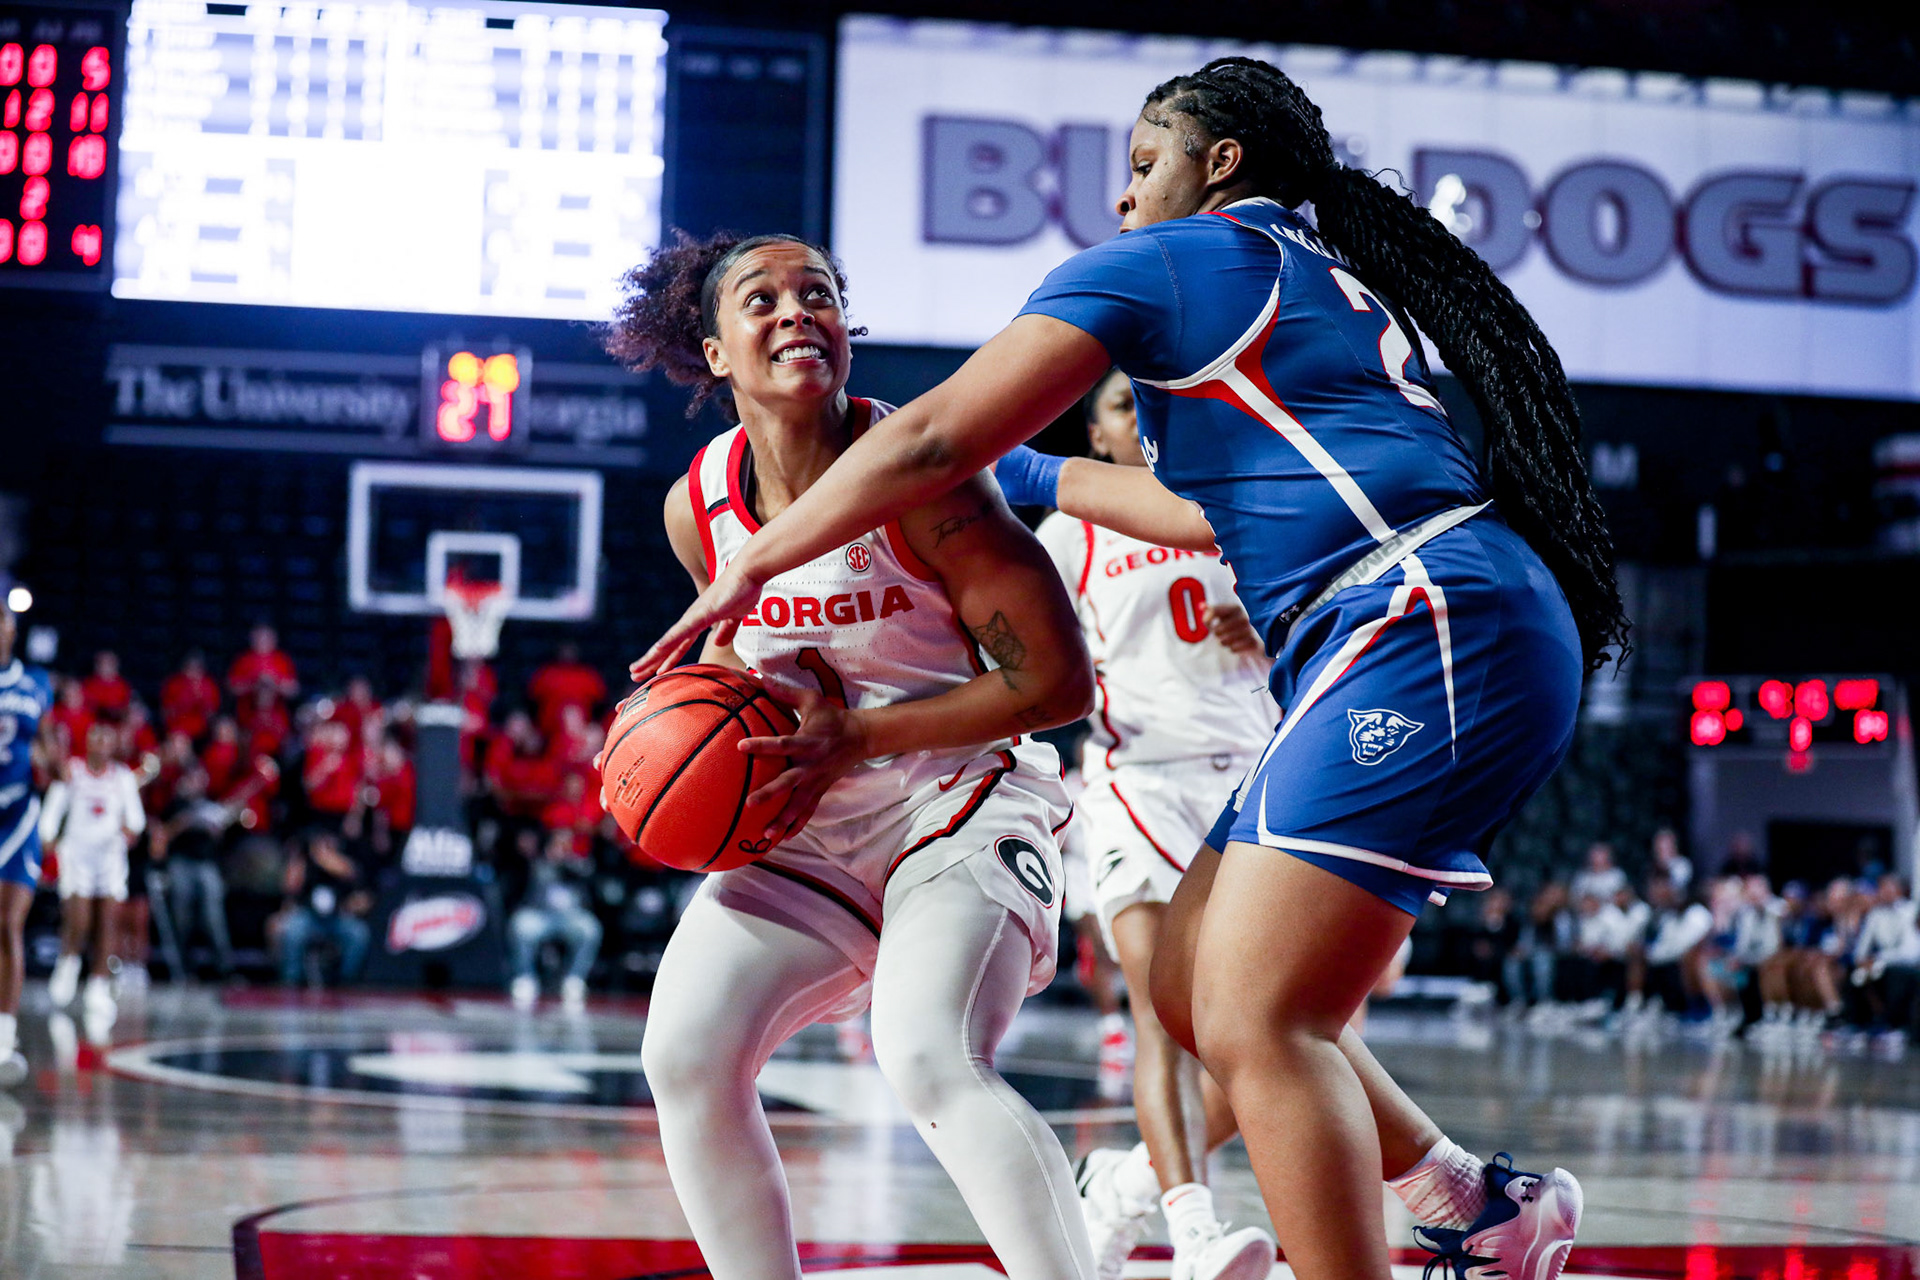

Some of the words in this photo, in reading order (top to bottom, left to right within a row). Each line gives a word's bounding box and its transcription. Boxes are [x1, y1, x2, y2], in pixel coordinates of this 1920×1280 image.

[920, 113, 1918, 305] BUDOGS
[848, 545, 869, 570] SEC
[1105, 546, 1221, 579] GEOR
[741, 584, 915, 629] EORGIA
[1168, 576, 1210, 644] 0
[795, 647, 849, 710] 1
